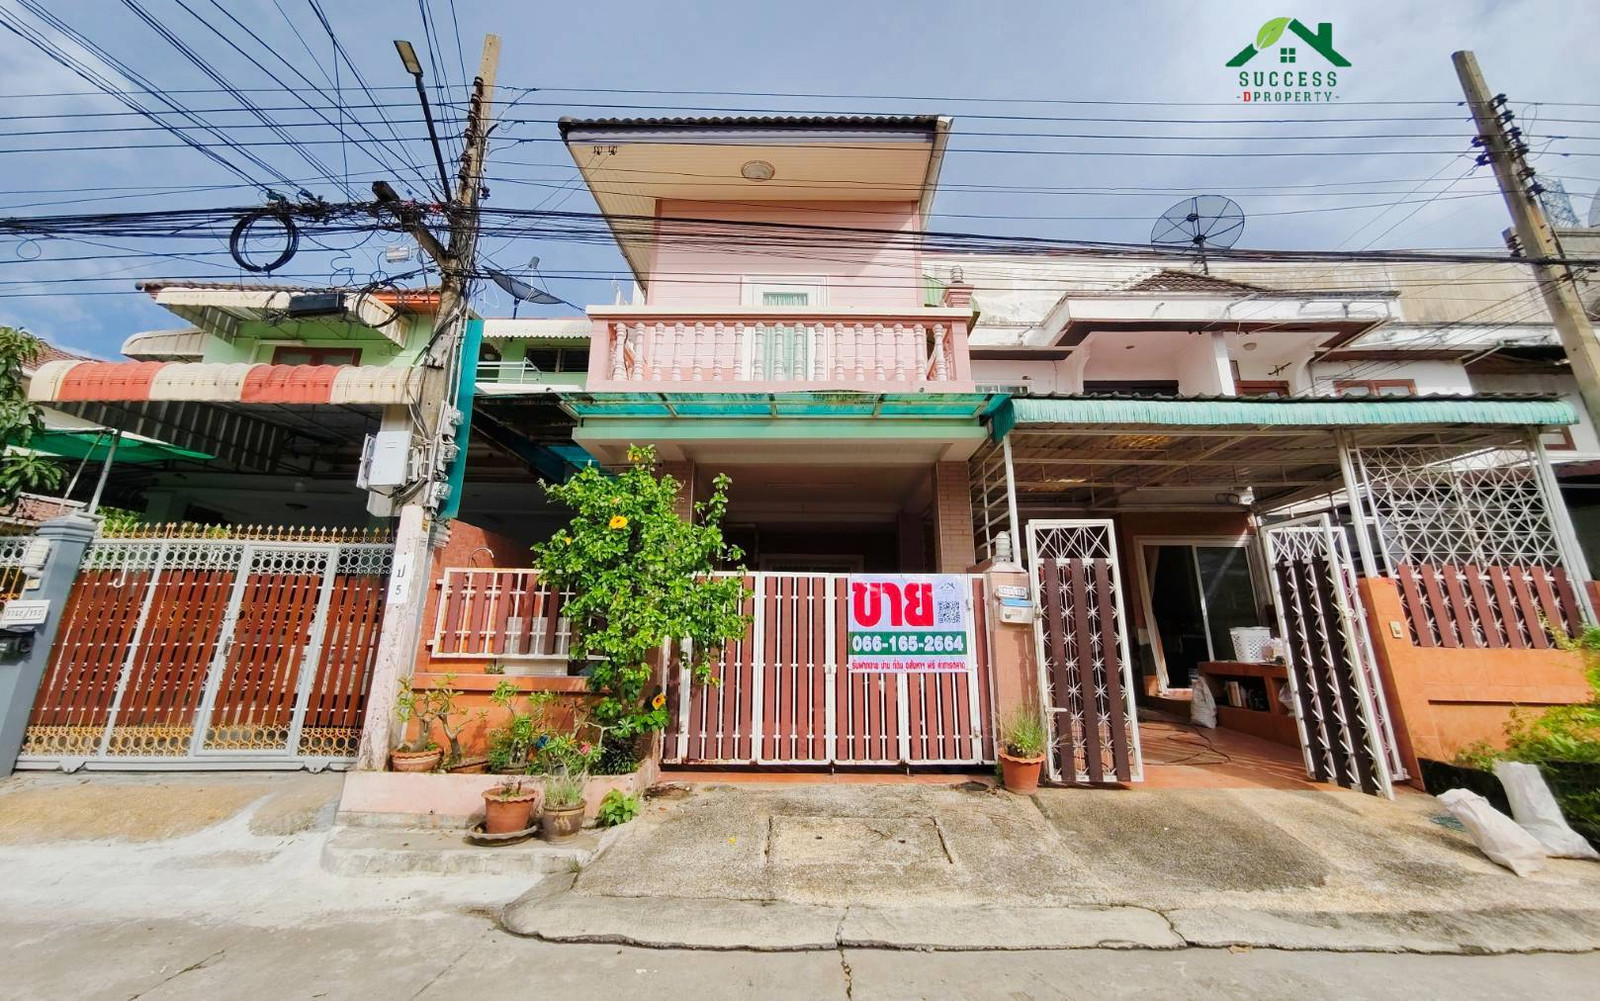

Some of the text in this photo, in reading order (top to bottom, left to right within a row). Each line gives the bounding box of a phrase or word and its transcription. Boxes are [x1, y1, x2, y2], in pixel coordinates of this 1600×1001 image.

[395, 584, 402, 596] 5
[852, 582, 934, 627] ขาย
[852, 635, 963, 652] 066-165-2664
